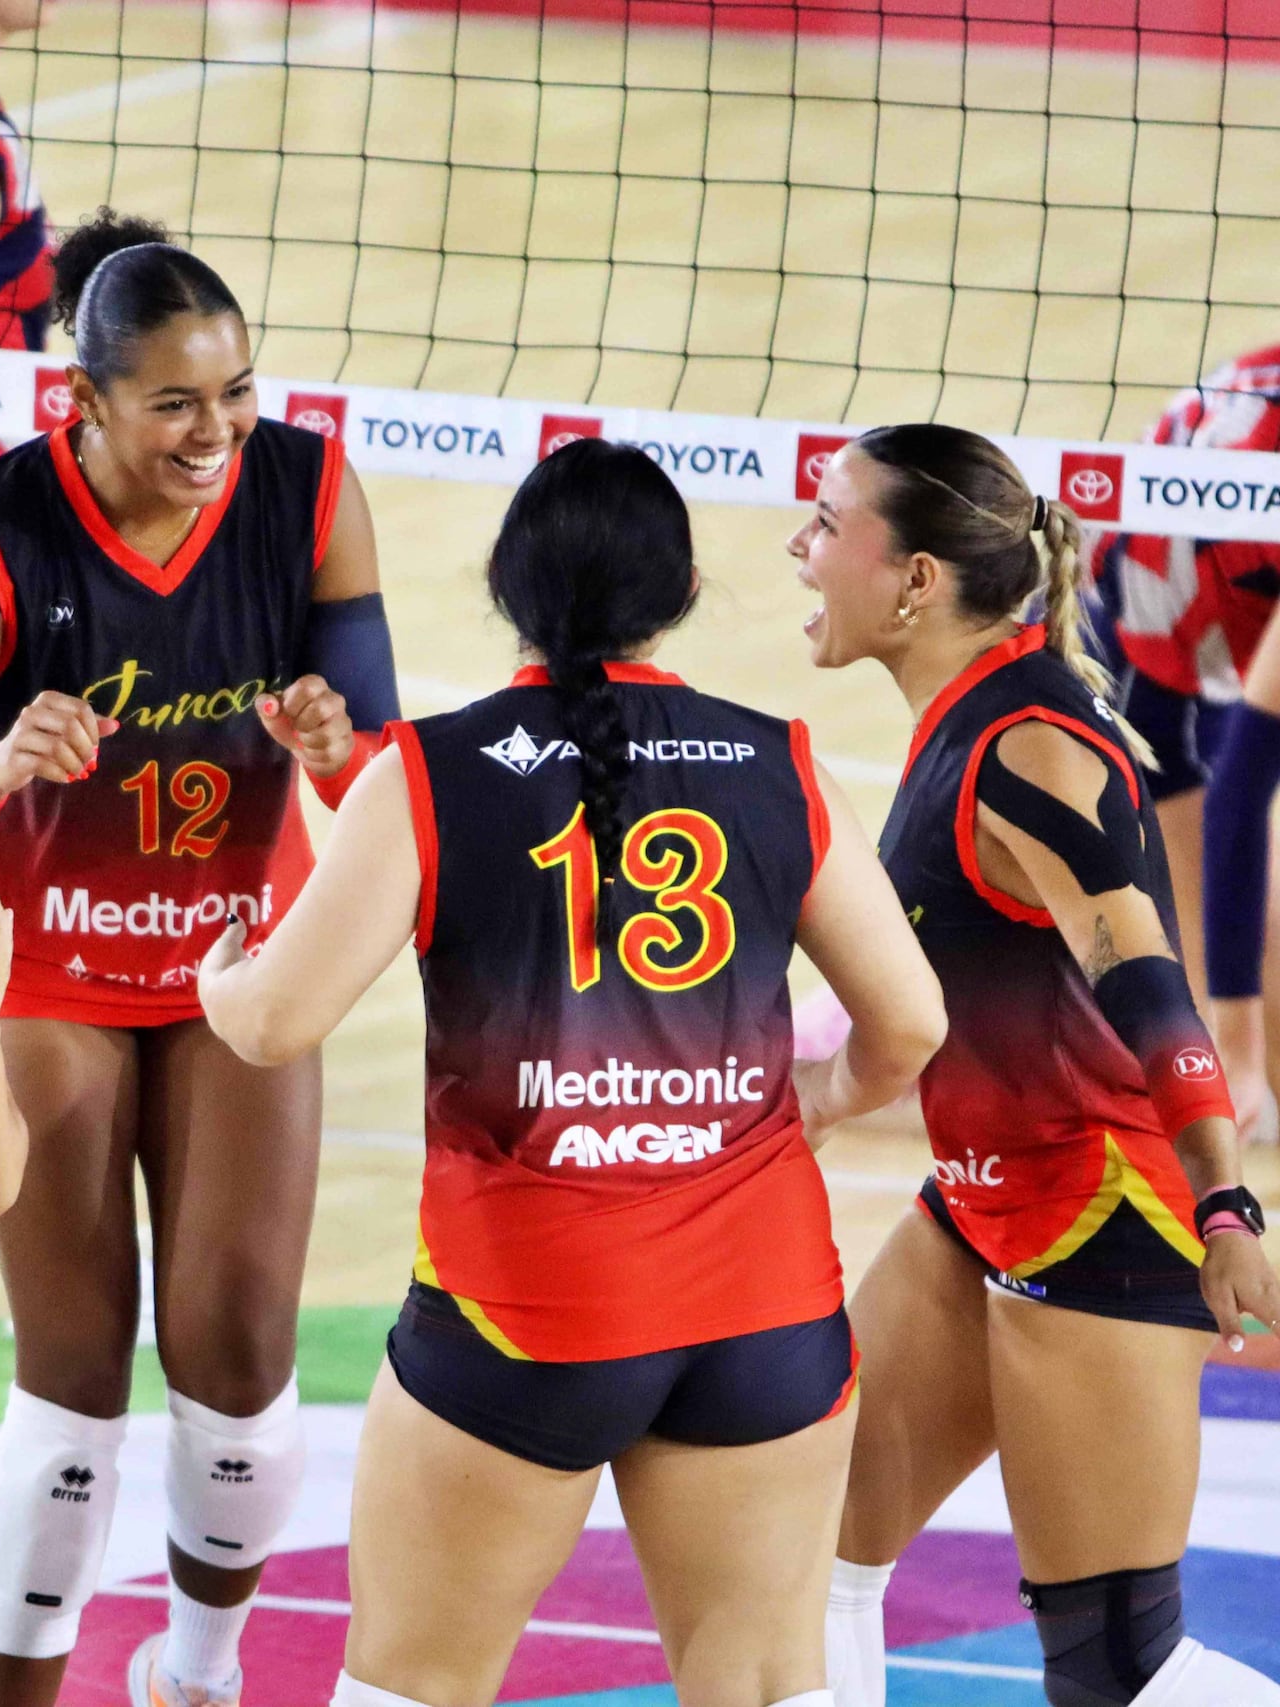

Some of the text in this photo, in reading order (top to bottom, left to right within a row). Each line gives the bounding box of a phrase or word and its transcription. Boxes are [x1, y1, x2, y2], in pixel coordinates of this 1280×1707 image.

[362, 416, 505, 457] TOYOTA
[618, 440, 763, 478] OYOTA
[1139, 475, 1280, 513] TOYOTA
[82, 659, 268, 734] Junco
[121, 760, 231, 858] 12
[43, 883, 273, 937] Medtroni
[528, 801, 736, 992] 13
[518, 1056, 764, 1108] Medtronic
[1176, 1050, 1216, 1078] DW
[549, 1121, 725, 1168] AMGEN
